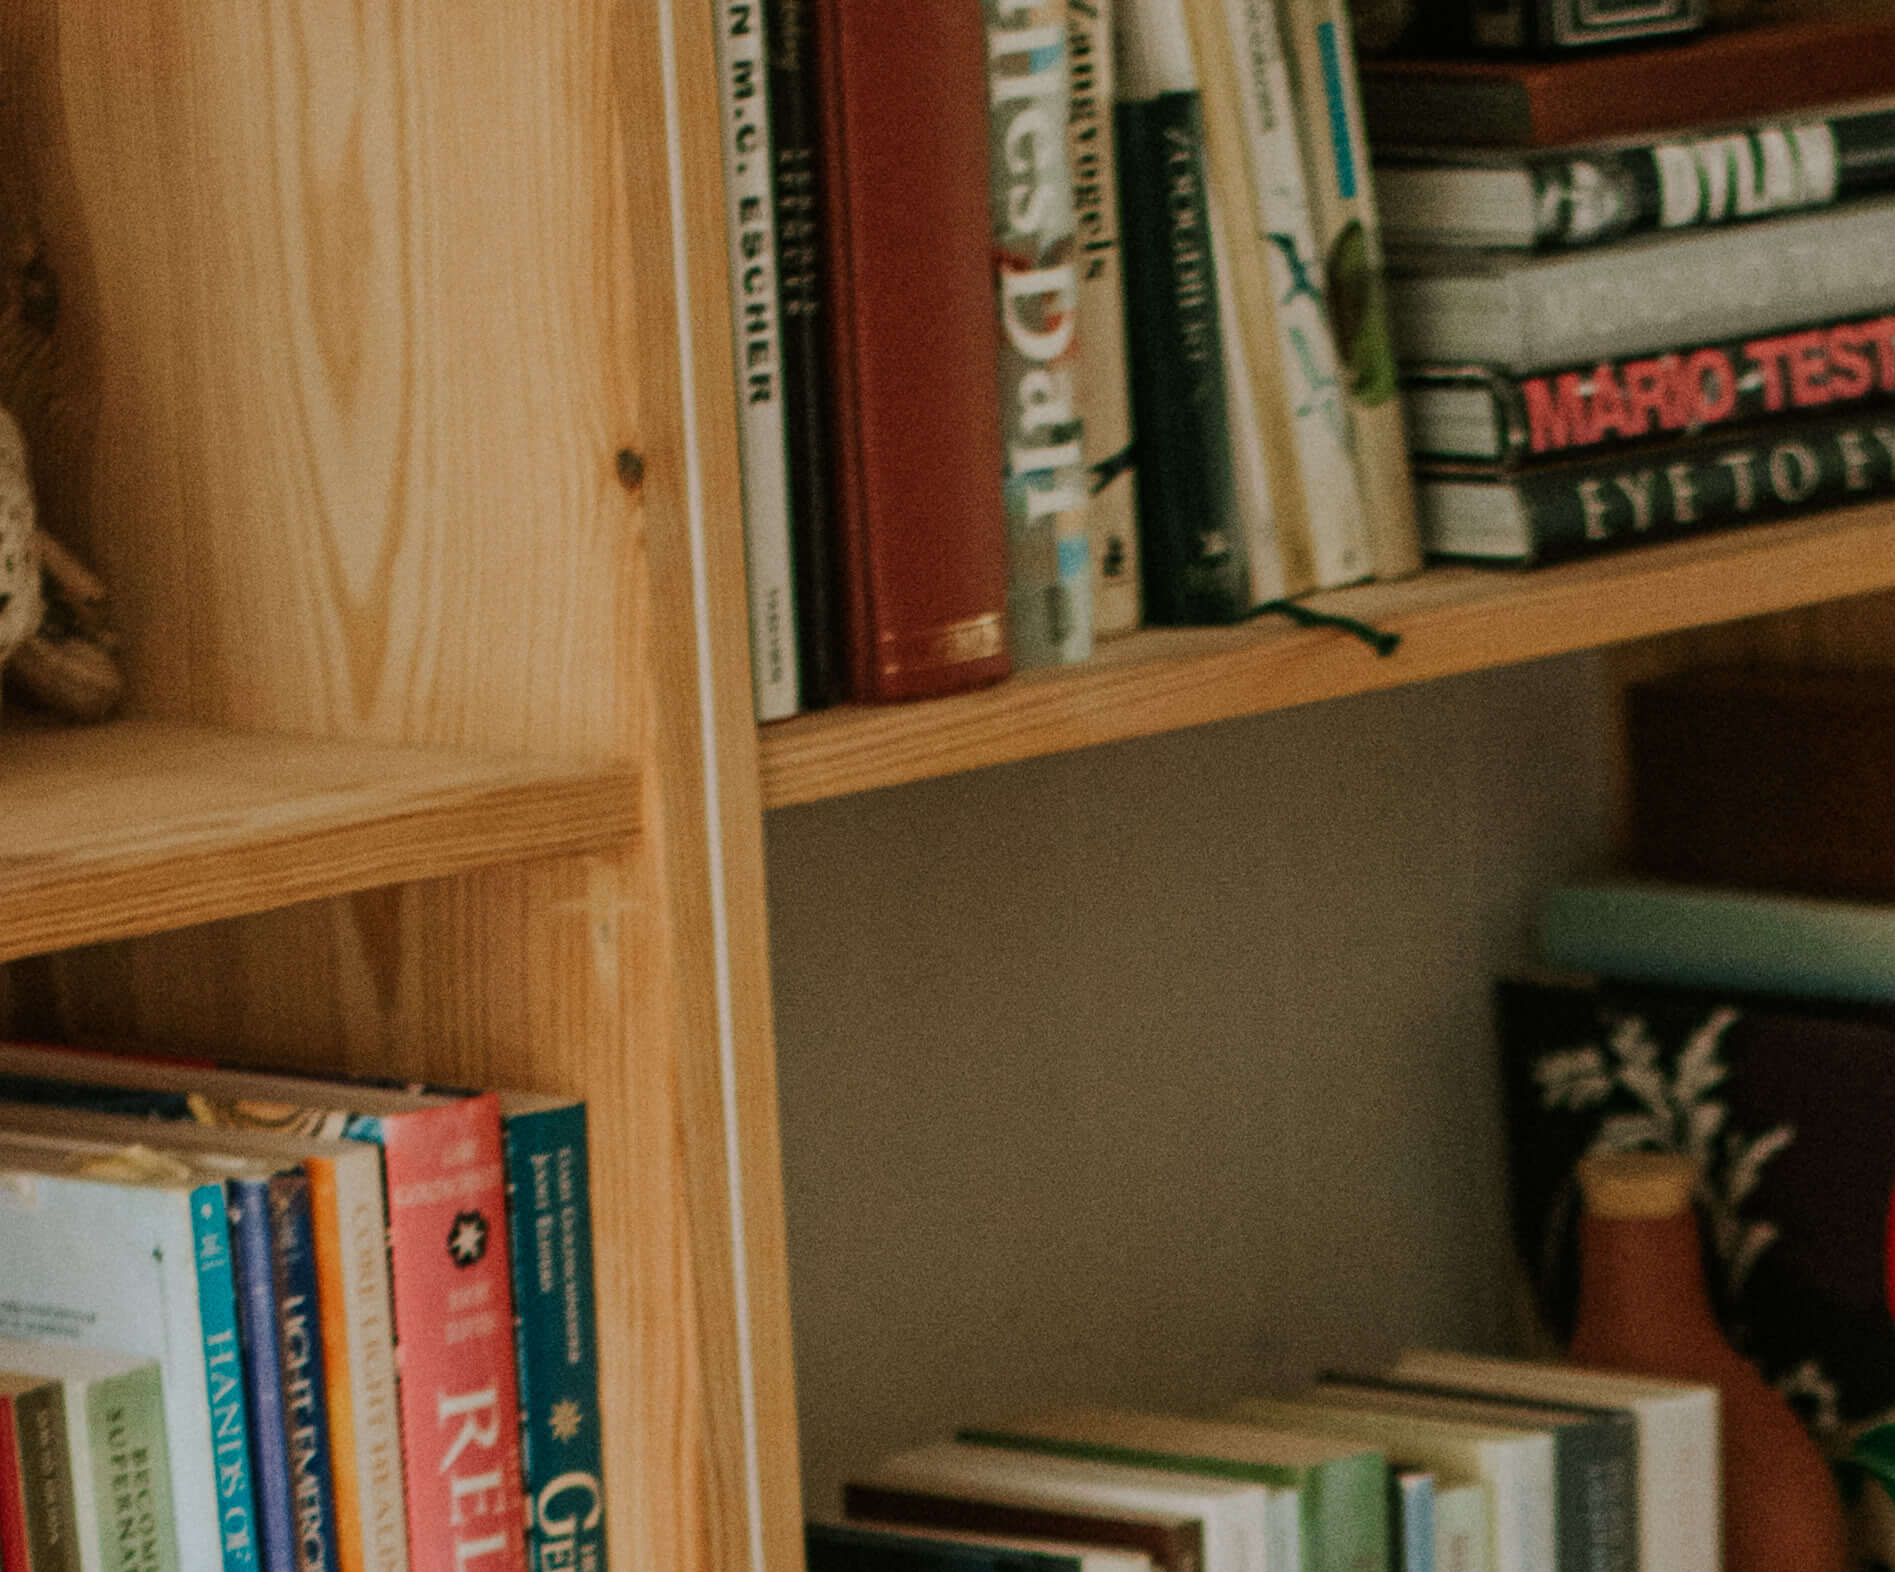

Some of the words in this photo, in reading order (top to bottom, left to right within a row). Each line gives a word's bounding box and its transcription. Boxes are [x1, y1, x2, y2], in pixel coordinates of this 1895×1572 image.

[986, 0, 1074, 238] lles
[736, 197, 774, 405] ESCHER
[1518, 342, 1741, 453] MARIO
[1575, 460, 1700, 539] EYE
[1717, 438, 1824, 512] TO
[202, 1328, 248, 1498] HANDS
[280, 1294, 313, 1413] LIGHT
[221, 1505, 252, 1565] OF
